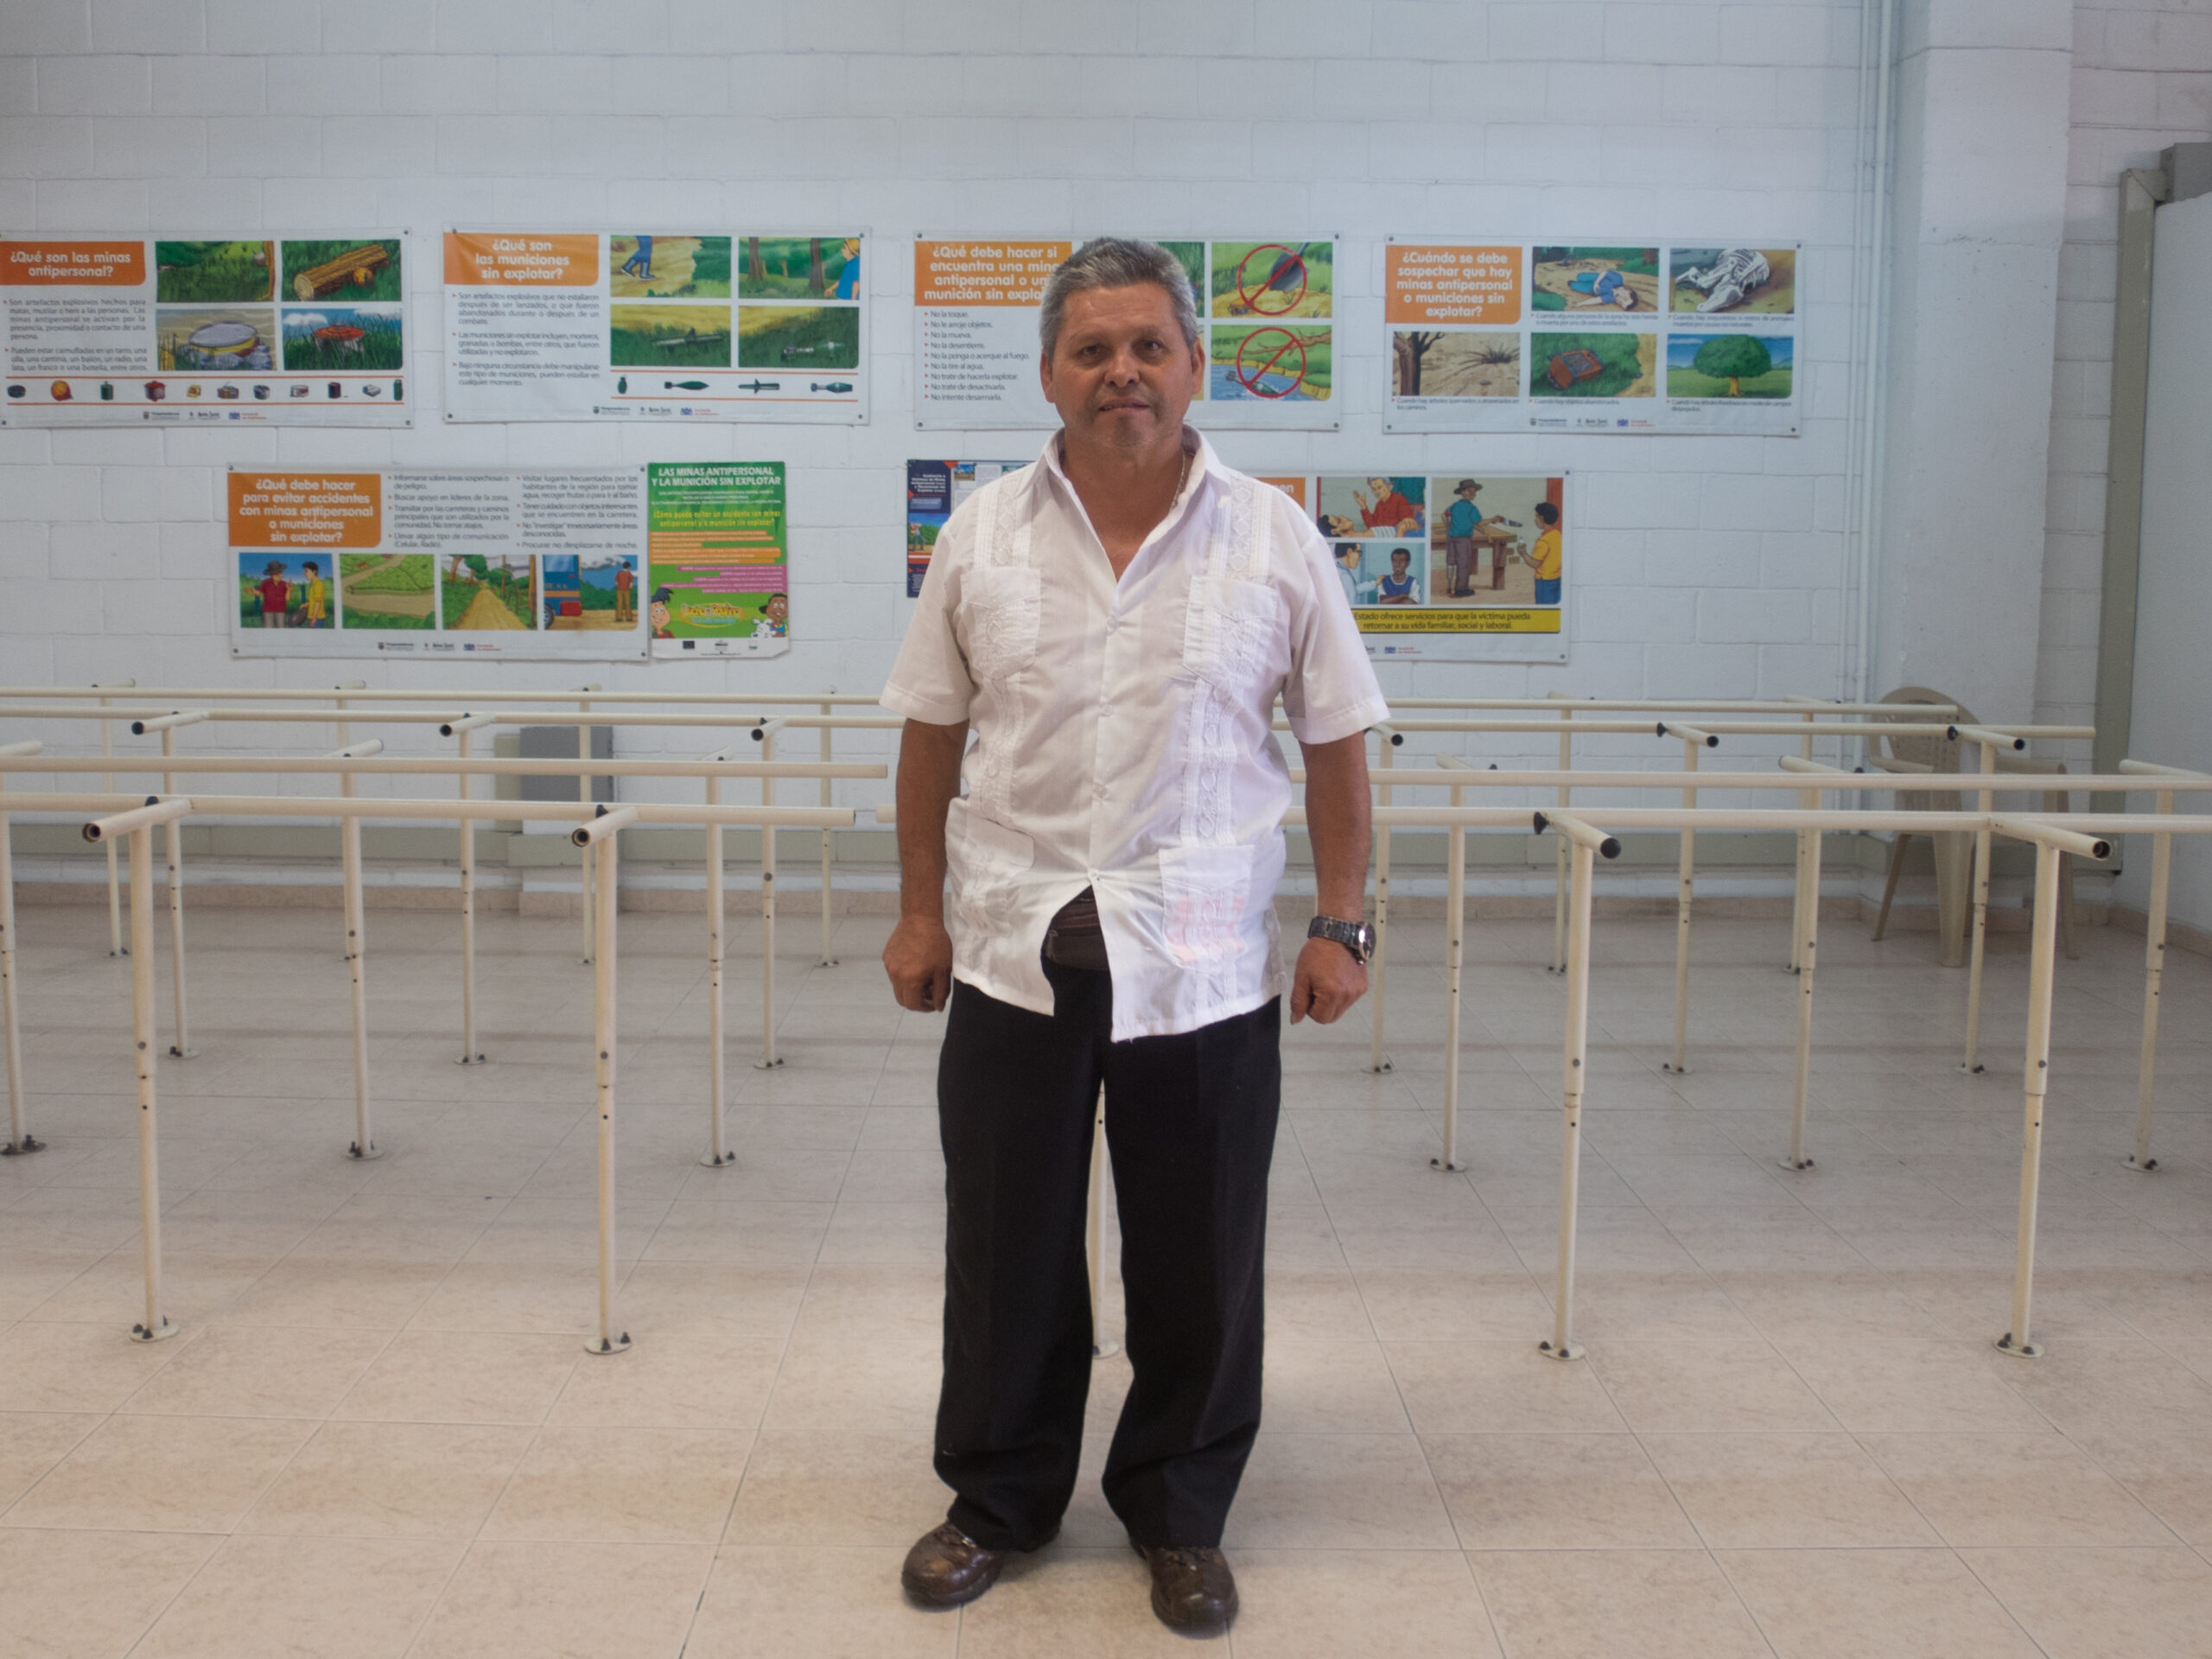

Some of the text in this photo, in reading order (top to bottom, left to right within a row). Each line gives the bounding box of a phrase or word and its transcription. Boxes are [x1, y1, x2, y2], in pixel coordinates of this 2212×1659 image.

[492, 239, 551, 251] ¿Qué son
[10, 251, 131, 263] ¿Qué son las minas
[932, 245, 1058, 258] ¿Qué debe hacer si
[475, 254, 569, 266] las municiones
[1402, 252, 1456, 263] ¿Cuándo
[1476, 253, 1507, 264] debe
[29, 265, 113, 278] antipersonal?
[930, 261, 994, 271] encuentra
[998, 263, 1023, 271] una
[480, 268, 563, 282] sin explotar?
[1397, 266, 1511, 279] sospechar que hay
[934, 274, 1014, 288] antipersonal
[1031, 276, 1048, 285] un
[1396, 278, 1512, 293] minas antipersonal
[924, 287, 1043, 302] munición sin explo
[1415, 292, 1484, 303] municiones
[1487, 293, 1504, 303] sin
[1426, 306, 1482, 318] explotar?
[706, 467, 772, 476] ANTIPERSONAL
[256, 480, 355, 491] ¿Qué debe hacer
[672, 477, 718, 486] MUNICIÓN
[242, 493, 370, 505] para evitar accidentes
[239, 505, 374, 519] con minas antipersonal
[280, 518, 344, 530] municiones
[270, 531, 342, 544] sin explotar?
